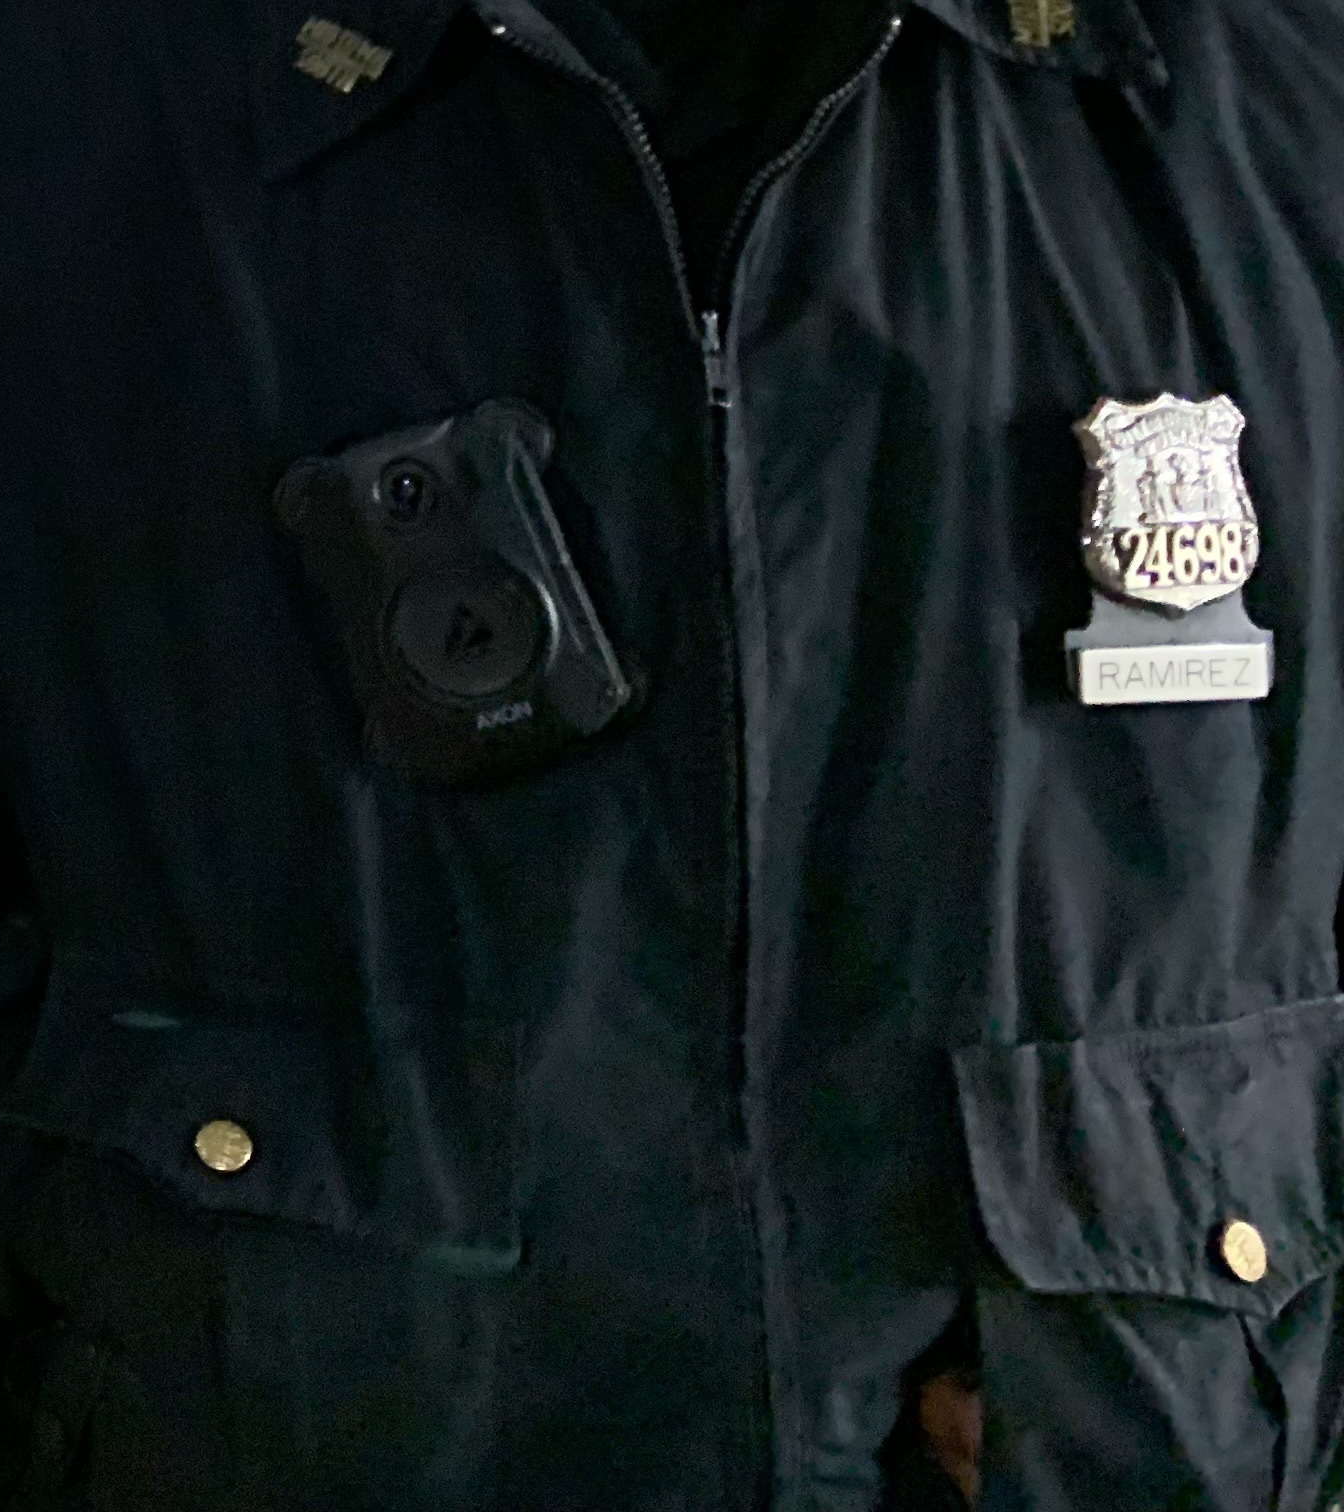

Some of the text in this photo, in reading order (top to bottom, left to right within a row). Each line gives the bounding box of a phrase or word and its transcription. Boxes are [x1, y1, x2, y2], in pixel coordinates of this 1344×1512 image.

[1123, 522, 1245, 589] 24698
[1098, 657, 1252, 691] RAMIREZ
[477, 701, 533, 730] AXON
